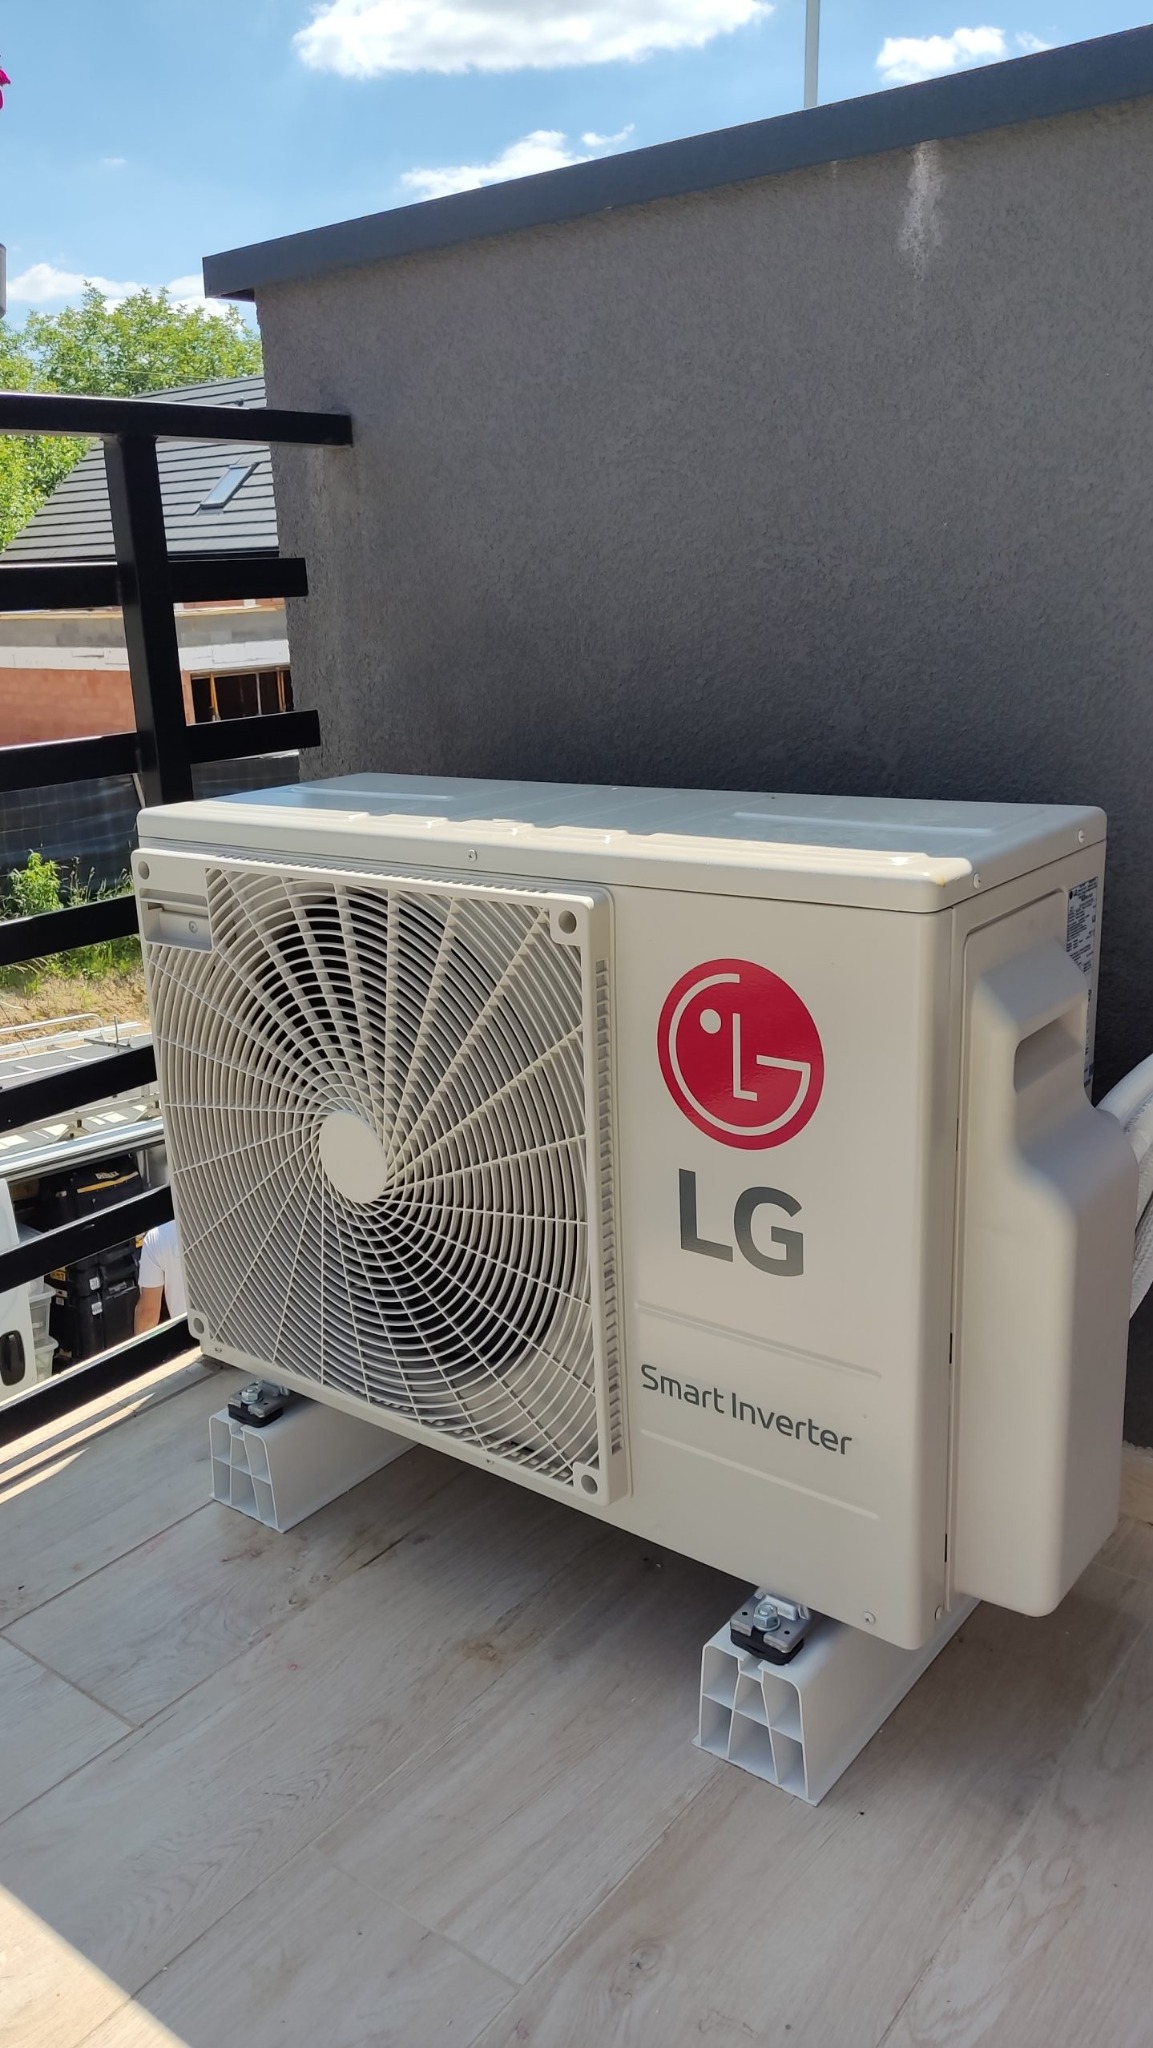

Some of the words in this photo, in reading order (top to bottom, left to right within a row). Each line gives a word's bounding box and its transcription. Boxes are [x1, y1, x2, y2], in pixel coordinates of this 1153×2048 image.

[668, 972, 811, 1137] LG
[678, 1168, 804, 1277] LG
[640, 1363, 725, 1415] Smart
[731, 1392, 853, 1455] Inverter
